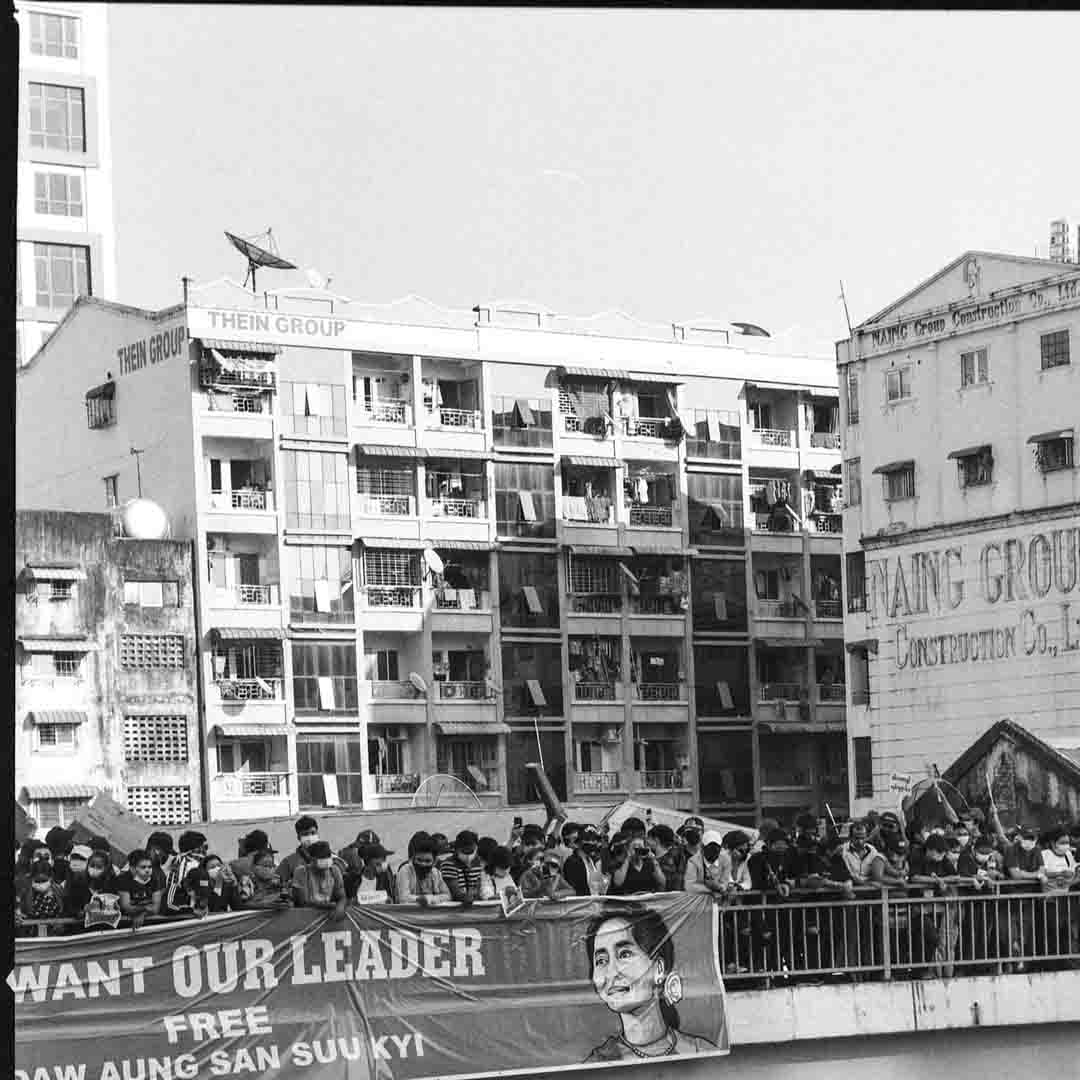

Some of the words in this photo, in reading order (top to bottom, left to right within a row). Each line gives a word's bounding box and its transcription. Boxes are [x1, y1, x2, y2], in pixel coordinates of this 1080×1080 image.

[207, 310, 270, 332] THEIN
[275, 316, 348, 337] GROUP
[118, 342, 147, 377] THEIN
[149, 325, 185, 365] GROUP
[868, 549, 964, 619] NAING
[6, 956, 153, 1003] WANT
[170, 936, 279, 999] OUR
[290, 927, 487, 986] LEADER
[163, 1005, 273, 1044] FREE
[209, 1044, 281, 1076] SAN
[292, 1036, 362, 1067] SUU
[370, 1032, 425, 1060] KYI
